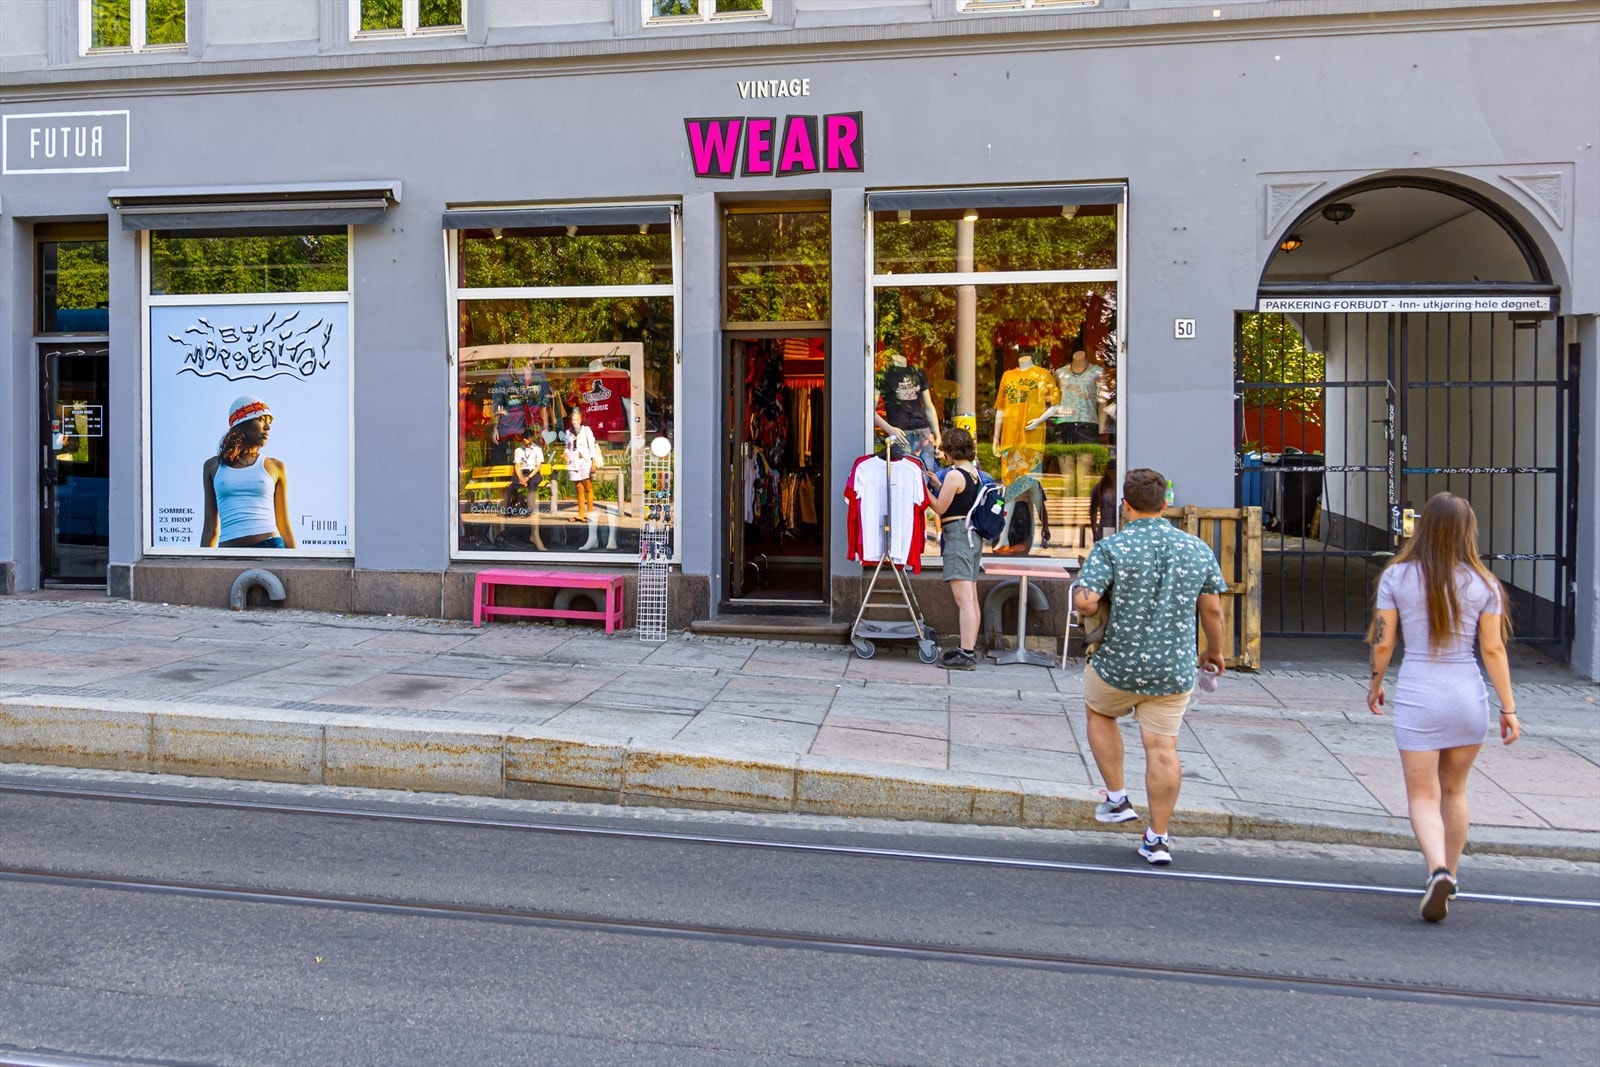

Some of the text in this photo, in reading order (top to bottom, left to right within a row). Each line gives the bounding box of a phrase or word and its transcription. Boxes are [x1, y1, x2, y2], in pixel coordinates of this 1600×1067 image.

[737, 78, 810, 99] VINTAGE
[687, 114, 859, 175] WEAR
[1265, 301, 1331, 309] PARKERING
[1334, 300, 1388, 309] FORBUDT
[1423, 299, 1472, 310] utkjøring
[1474, 300, 1498, 308] hele
[1501, 300, 1543, 310] døgnet.
[1178, 321, 1192, 336] 50
